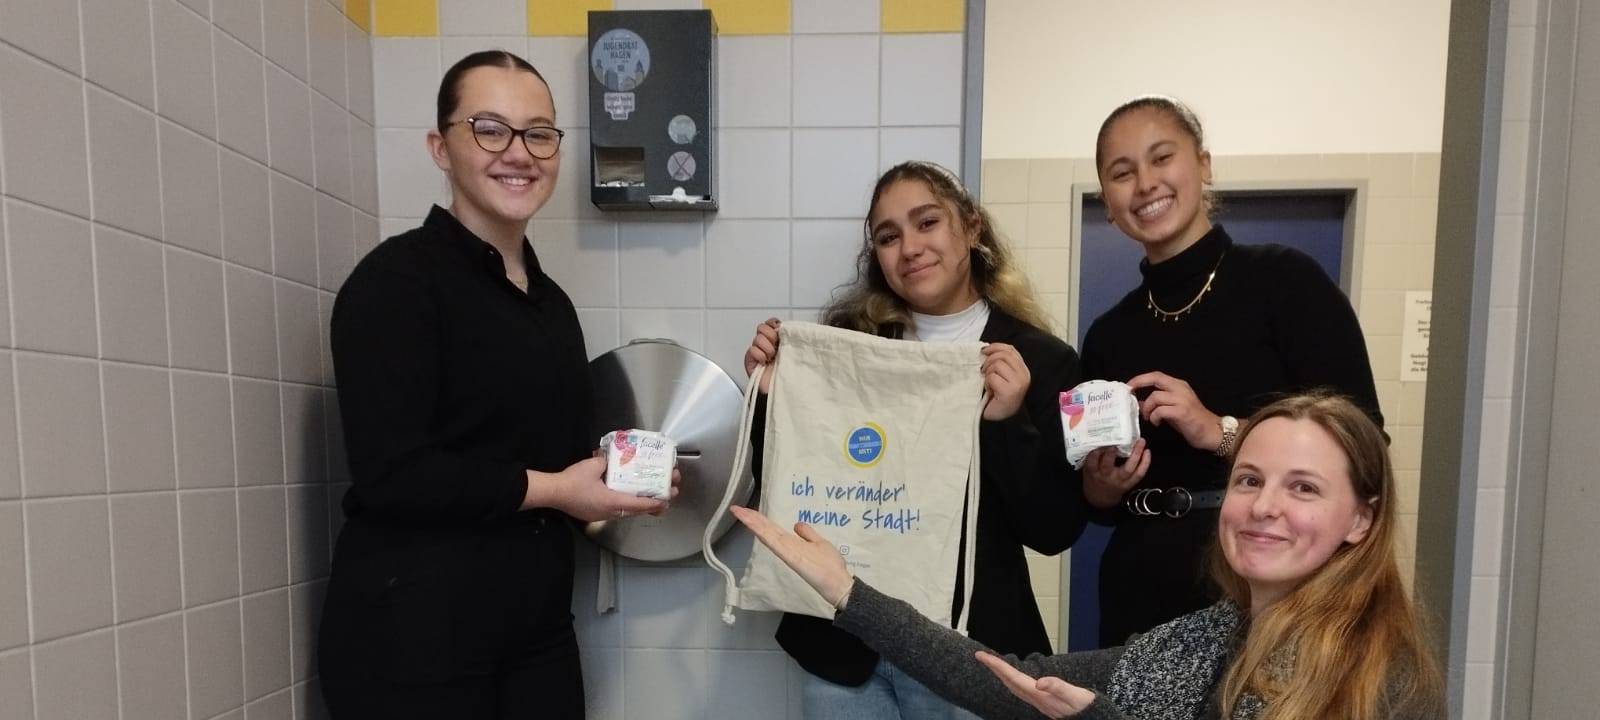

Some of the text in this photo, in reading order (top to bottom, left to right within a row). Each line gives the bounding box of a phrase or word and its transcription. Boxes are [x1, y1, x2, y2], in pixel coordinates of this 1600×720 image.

[610, 50, 631, 59] HAGEN
[1088, 391, 1112, 404] facelle
[791, 473, 815, 497] ich
[798, 503, 921, 535] meine Stadt!
